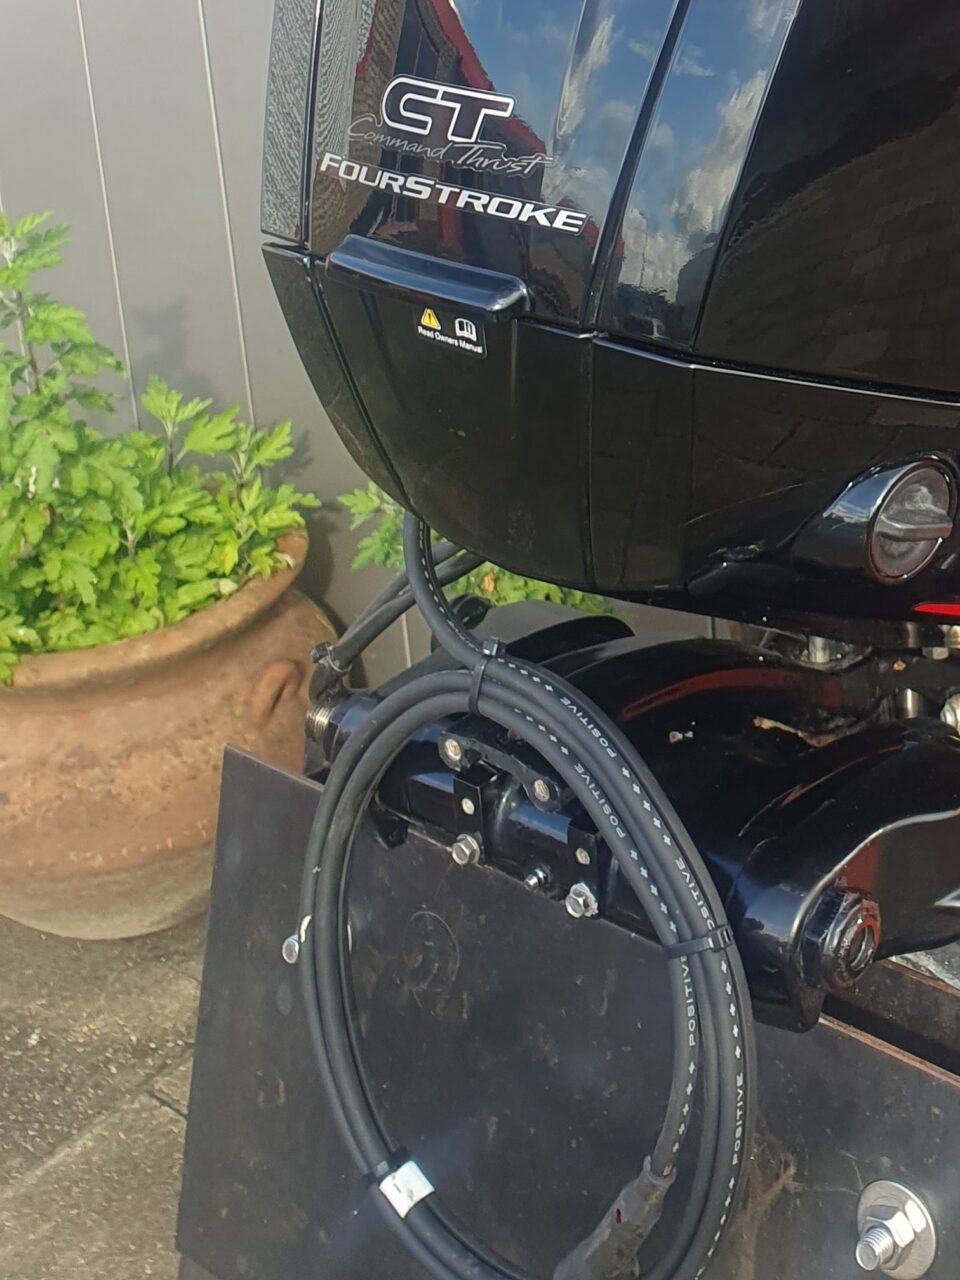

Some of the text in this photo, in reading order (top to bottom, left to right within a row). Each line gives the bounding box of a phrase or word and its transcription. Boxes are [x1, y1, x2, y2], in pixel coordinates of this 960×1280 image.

[347, 114, 554, 176] Command Thrust
[319, 152, 588, 233] FOURSTROKE
[417, 325, 483, 354] Read Owners Manual
[559, 696, 617, 758] POSITIVE
[574, 763, 626, 839] POSITIVE
[674, 856, 716, 931] OSITIVE
[731, 1072, 744, 1166] POSITIVE
